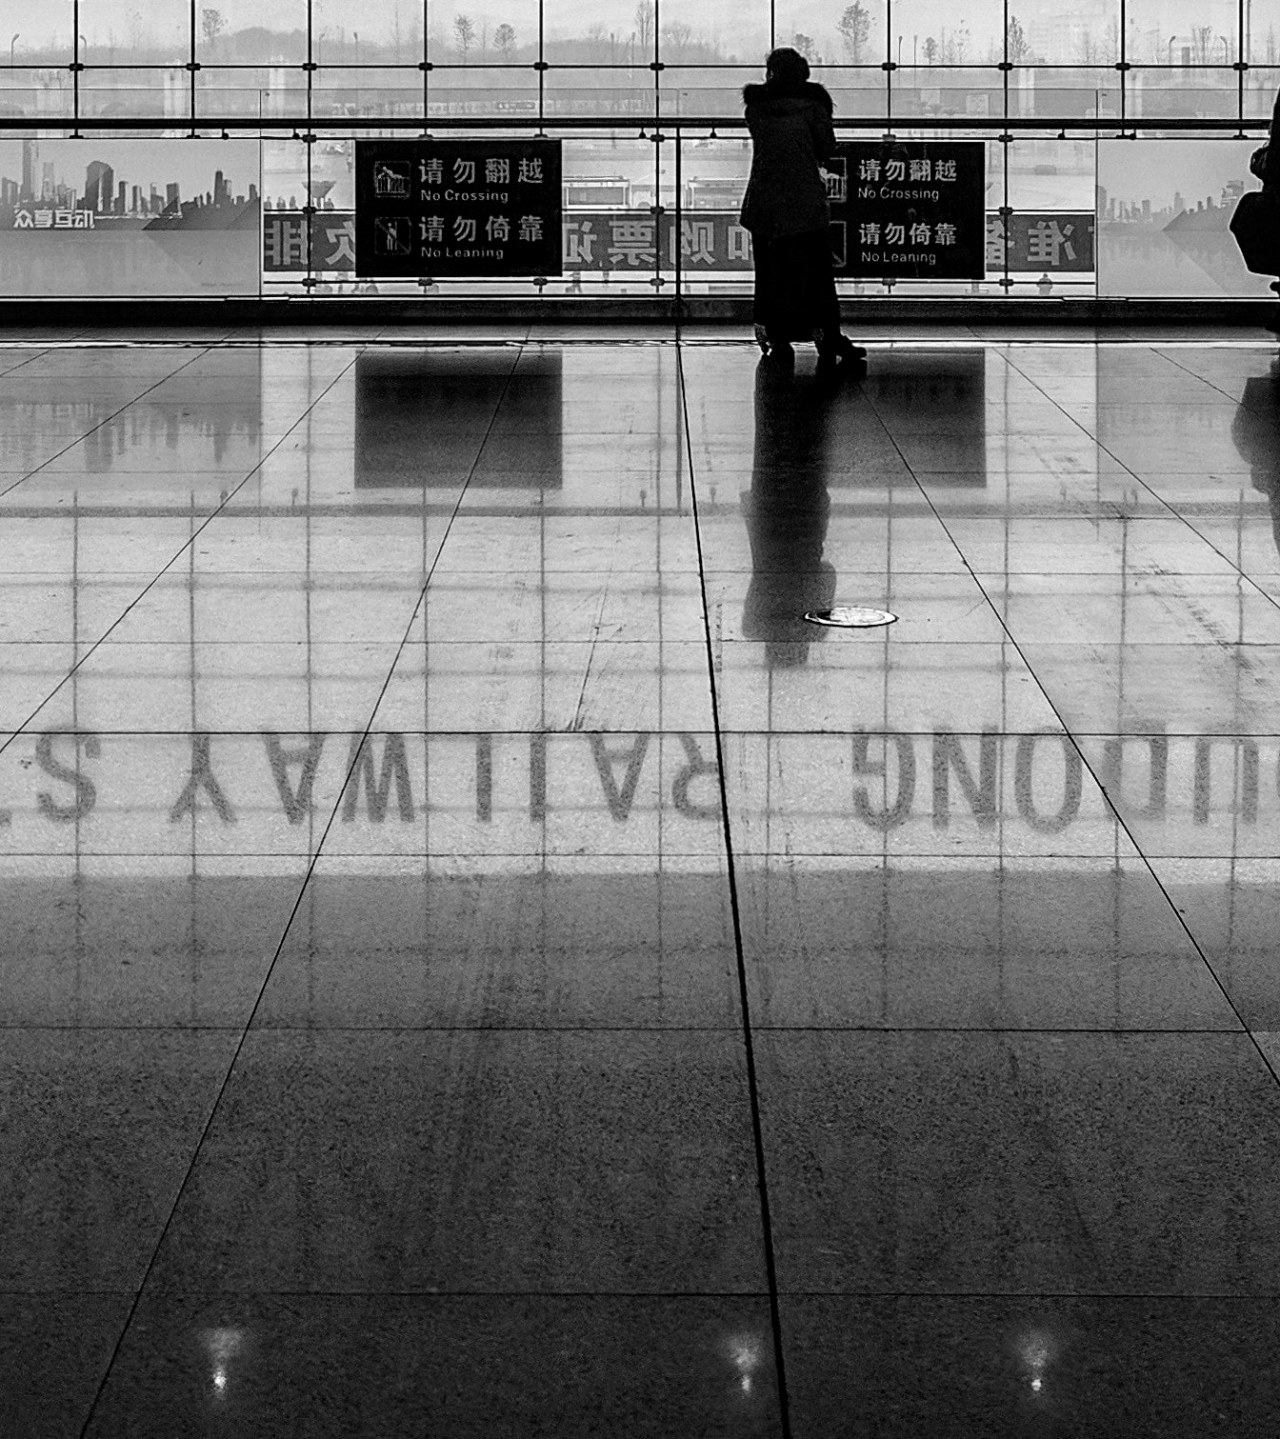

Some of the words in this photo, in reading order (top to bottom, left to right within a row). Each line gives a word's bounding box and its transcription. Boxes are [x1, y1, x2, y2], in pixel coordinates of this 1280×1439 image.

[418, 157, 544, 185] 请勿翻越
[858, 158, 958, 182] 请勿翻越
[420, 190, 441, 202] No
[444, 188, 509, 204] Crossing
[858, 187, 877, 200] No
[879, 186, 940, 203] Crossing
[418, 215, 544, 242] 请勿倚靠
[858, 222, 958, 246] 请勿倚靠
[420, 246, 441, 258] No
[445, 246, 504, 260] Leaning
[861, 251, 879, 263] No
[883, 251, 937, 266] Leaning
